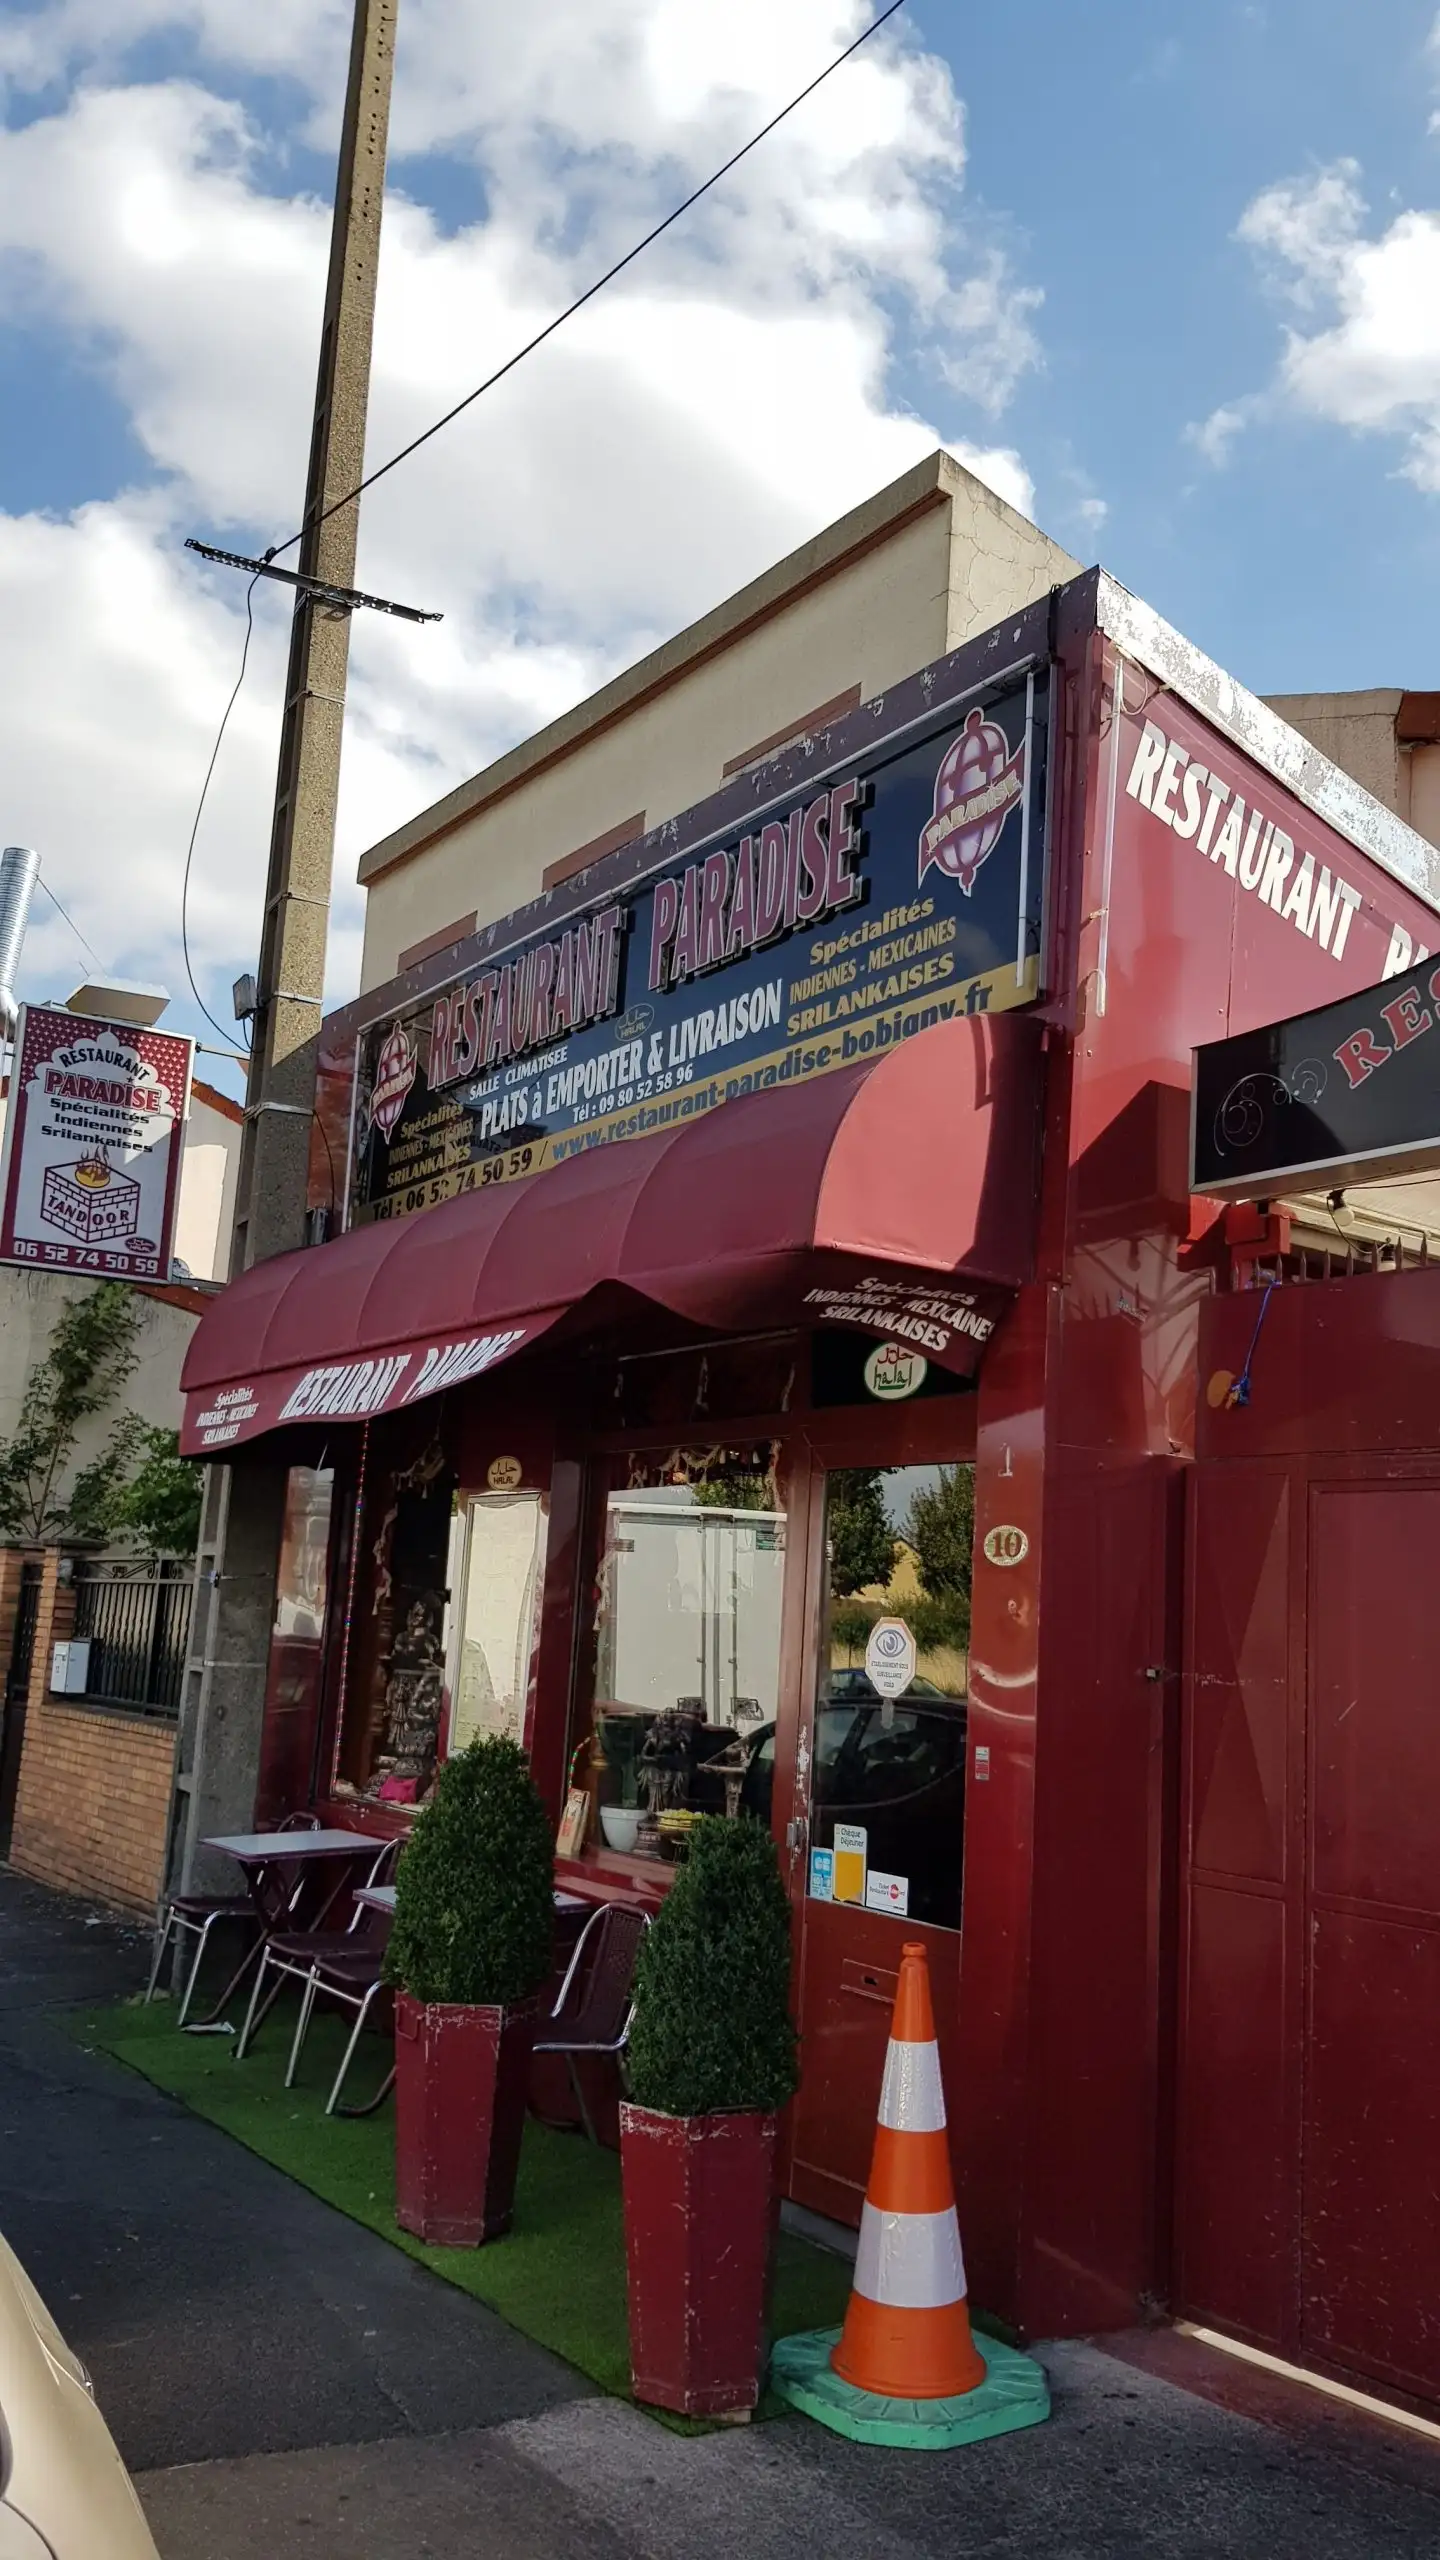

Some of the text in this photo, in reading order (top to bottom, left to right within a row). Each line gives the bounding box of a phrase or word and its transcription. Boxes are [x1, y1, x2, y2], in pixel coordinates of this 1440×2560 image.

[1125, 717, 1362, 961] RESTAURANT
[428, 777, 861, 1090] RESTAURANT PARADISE
[810, 897, 935, 966] Spécialités
[789, 958, 857, 1006] INDIENNES
[867, 916, 956, 974] MEXICAINES
[786, 952, 955, 1037] SRILANKAISES
[59, 1047, 150, 1081] RESTAURANT
[469, 1046, 568, 1101] SALLE CLIMATISEE
[480, 978, 783, 1140] PLATS à EMPORTER & LIVRAISON
[44, 1069, 162, 1114] PARADISE
[50, 1097, 150, 1124] Spécialités
[599, 1095, 614, 1115] 09
[617, 1088, 633, 1107] 80
[636, 1079, 653, 1100] 52
[656, 1072, 673, 1094] 58
[676, 1063, 693, 1086] 96
[41, 1125, 153, 1153] Srilankaises
[54, 1112, 143, 1138] Indiennes
[406, 1185, 425, 1213] 06
[456, 1168, 476, 1196] 74
[481, 1158, 504, 1185] 50
[509, 1148, 533, 1175] 59
[47, 1194, 130, 1227] TANDOOR
[13, 1240, 158, 1274] 06 52 74 50 59
[802, 1288, 897, 1306] INDIENNES
[819, 1305, 951, 1351] SRILANKAISES
[278, 1353, 412, 1420] RESTAURANT
[873, 1362, 913, 1390] halal
[493, 1476, 515, 1485] HALAL
[992, 1531, 1022, 1557] 10
